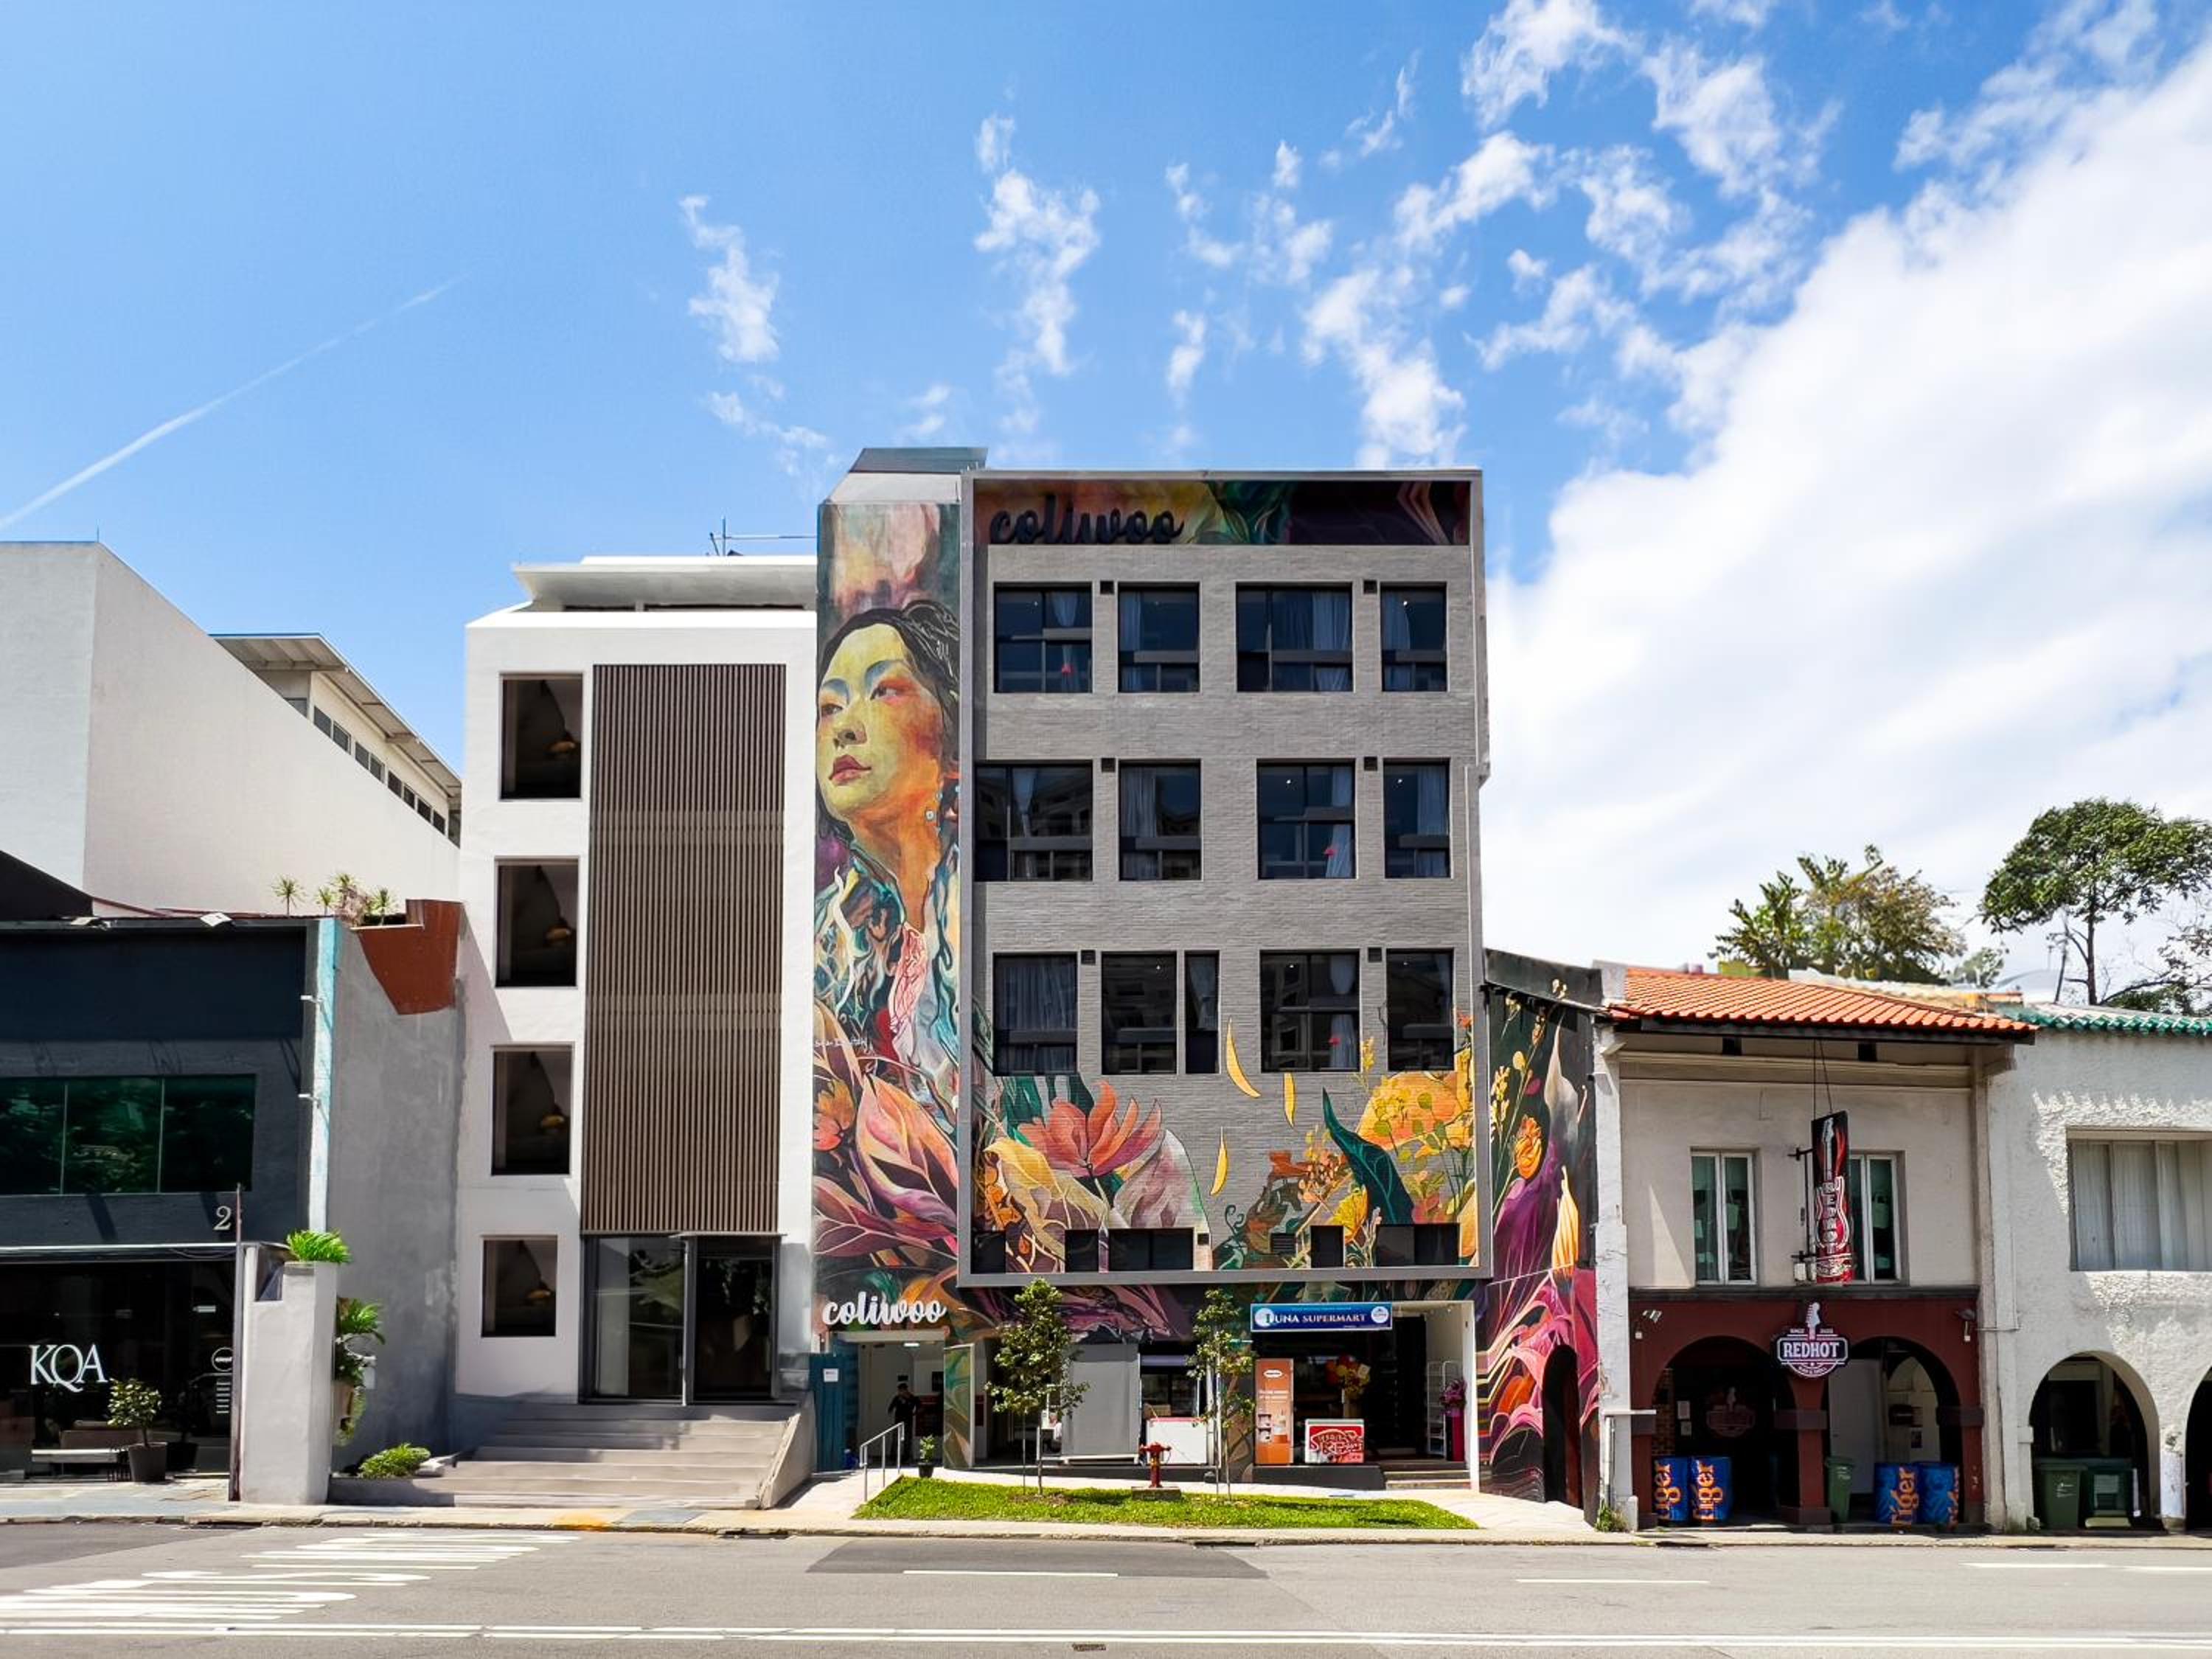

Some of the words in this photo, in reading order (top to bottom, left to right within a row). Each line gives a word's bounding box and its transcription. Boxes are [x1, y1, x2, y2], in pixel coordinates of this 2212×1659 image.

[989, 494, 1185, 544] coliwoo
[214, 1206, 232, 1231] 2
[822, 1291, 947, 1325] coliwoo
[1302, 1313, 1367, 1323] SUPERMART
[1783, 1342, 1840, 1357] REDHOT
[29, 1344, 108, 1393] KQA
